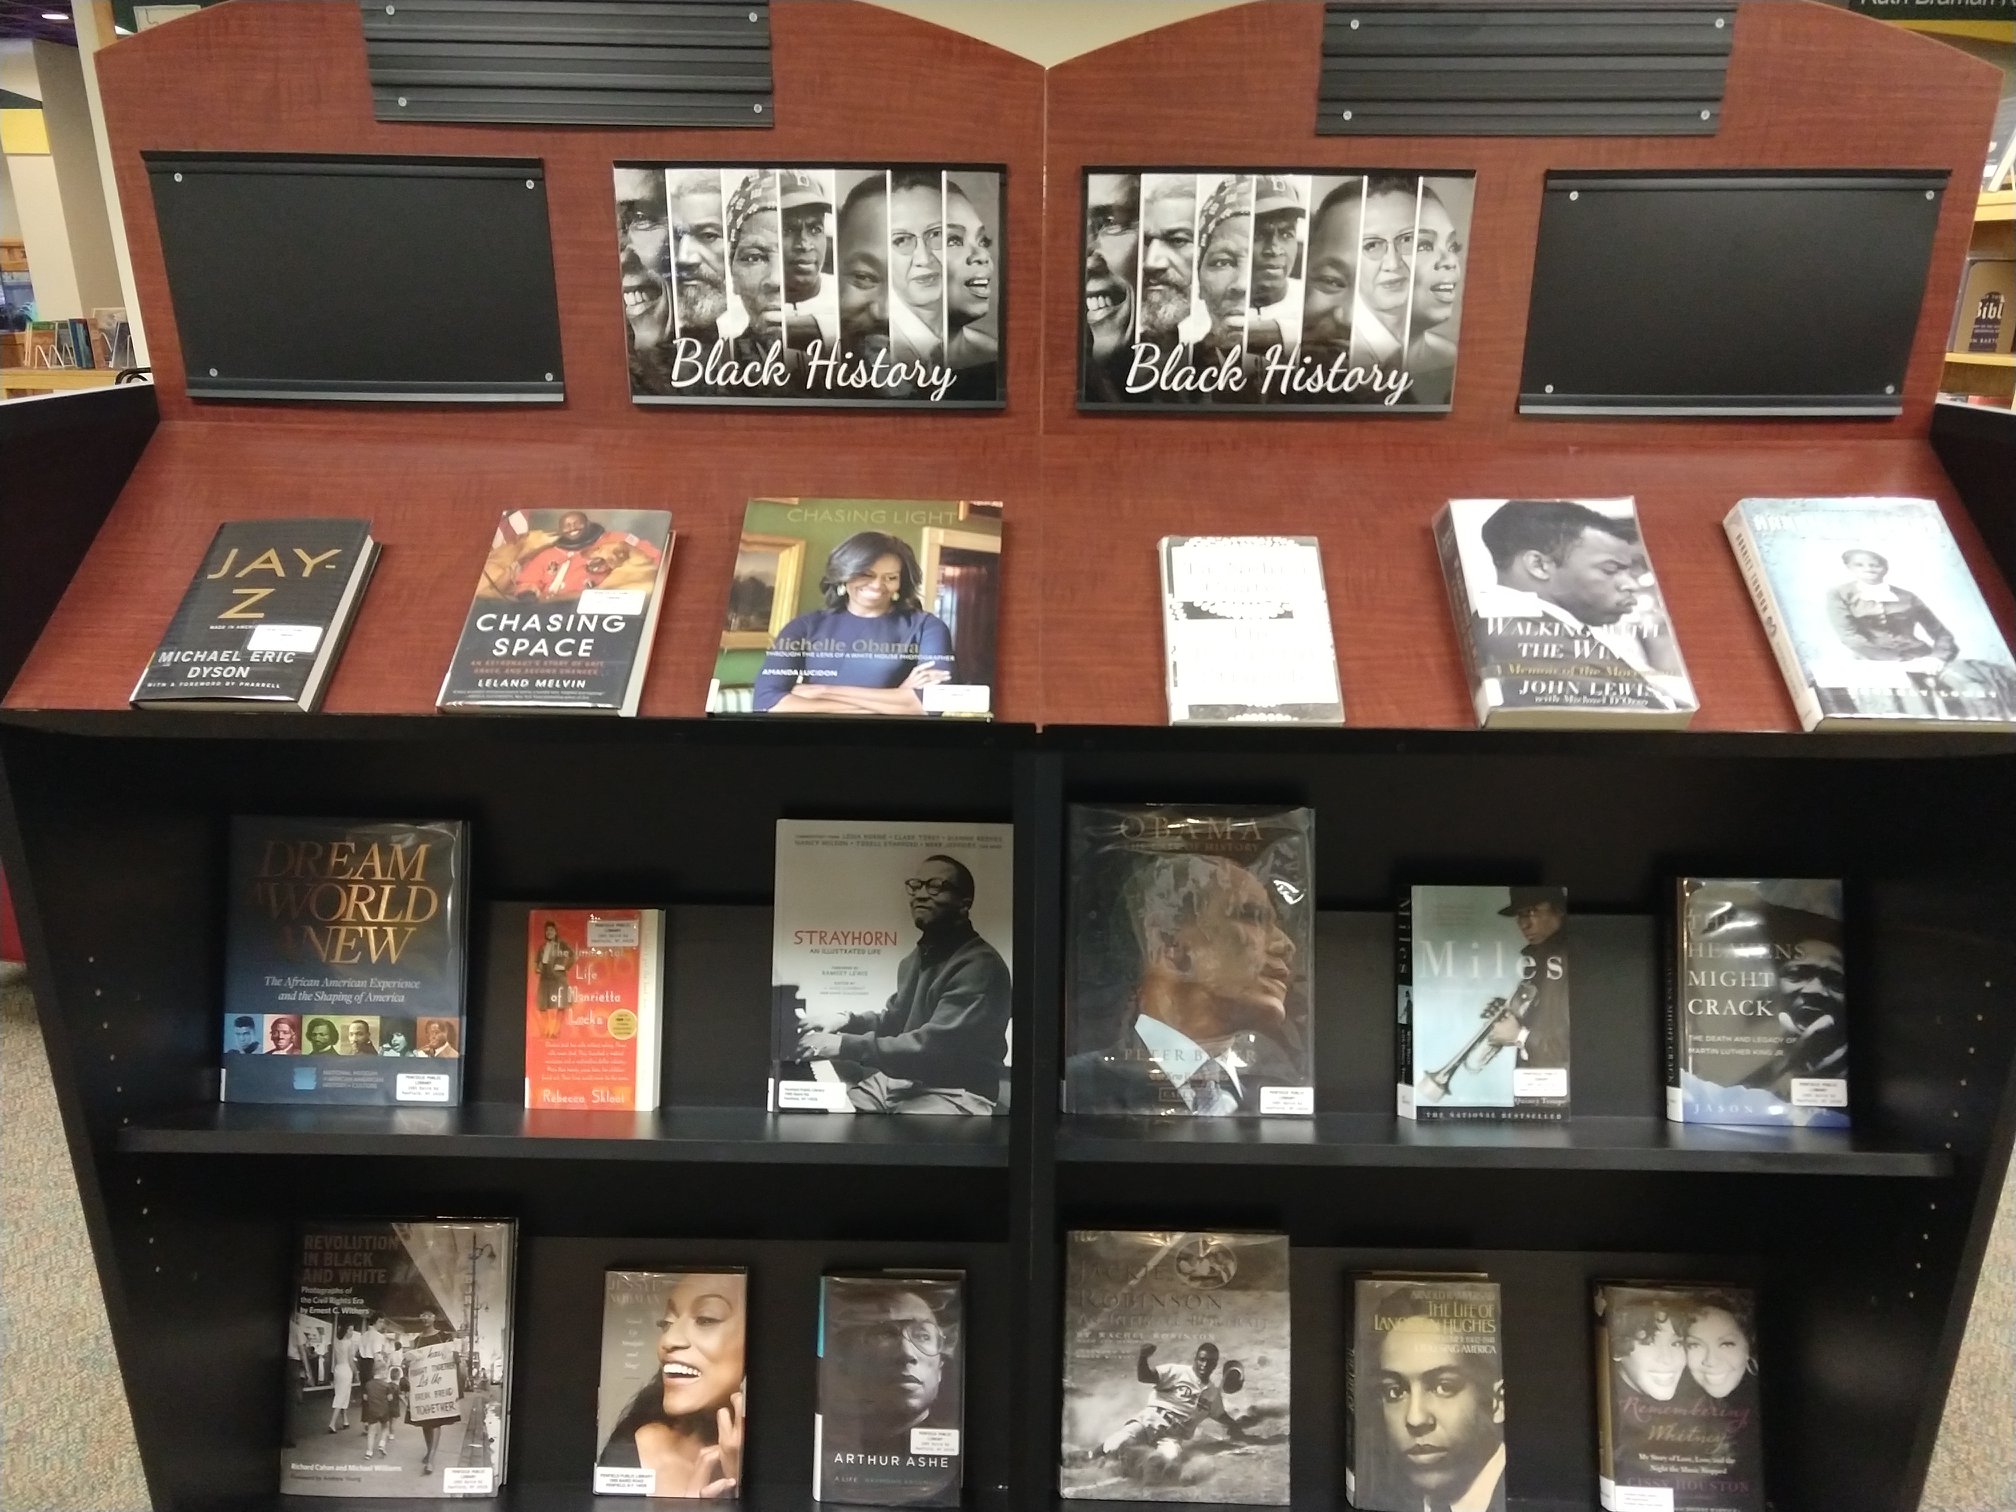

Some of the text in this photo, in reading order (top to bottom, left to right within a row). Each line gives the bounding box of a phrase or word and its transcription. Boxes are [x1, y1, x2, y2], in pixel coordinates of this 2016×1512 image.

[670, 337, 958, 402] Black History
[1125, 343, 1415, 407] Black History
[787, 508, 958, 526] CHASING LIGHT
[206, 548, 343, 580] JAY-
[217, 588, 276, 619] Z
[476, 613, 626, 633] CHASING
[1487, 616, 1592, 637] WALKING
[493, 638, 595, 658] SPACE
[767, 636, 920, 654] Michelle Obama
[1517, 643, 1565, 659] THE
[158, 651, 296, 664] MICHAEL ERIC
[187, 666, 251, 679] DYSON
[762, 669, 839, 678] AMANDA LUCIDON
[478, 679, 587, 690] LELAND MELVIN
[1519, 680, 1580, 696] JOHN
[1121, 816, 1263, 841] OBAMA
[258, 841, 432, 881] DREAM
[256, 883, 438, 923] WORLD
[794, 931, 898, 946] STRAYHORN
[1419, 940, 1564, 980] Miles
[576, 963, 598, 985] Life
[1688, 970, 1776, 987] MIGHT
[264, 976, 421, 991] The African American Experience
[278, 991, 406, 1005] and the Shaping of America
[550, 986, 564, 1008] of
[1688, 998, 1775, 1017] CRACK
[543, 1089, 625, 1104] Rebecca Skloot
[1694, 1104, 1753, 1115] JASON
[304, 1235, 400, 1250] REVOLUTION
[304, 1252, 374, 1266] IN BLACK
[303, 1268, 387, 1284] AND WHITE
[345, 1287, 353, 1295] of
[1428, 1301, 1496, 1319] THE LIFE OF
[1444, 1318, 1497, 1334] HUGHES
[1461, 1344, 1497, 1354] AMERICA
[833, 1452, 949, 1468] ARTHUR ASHE
